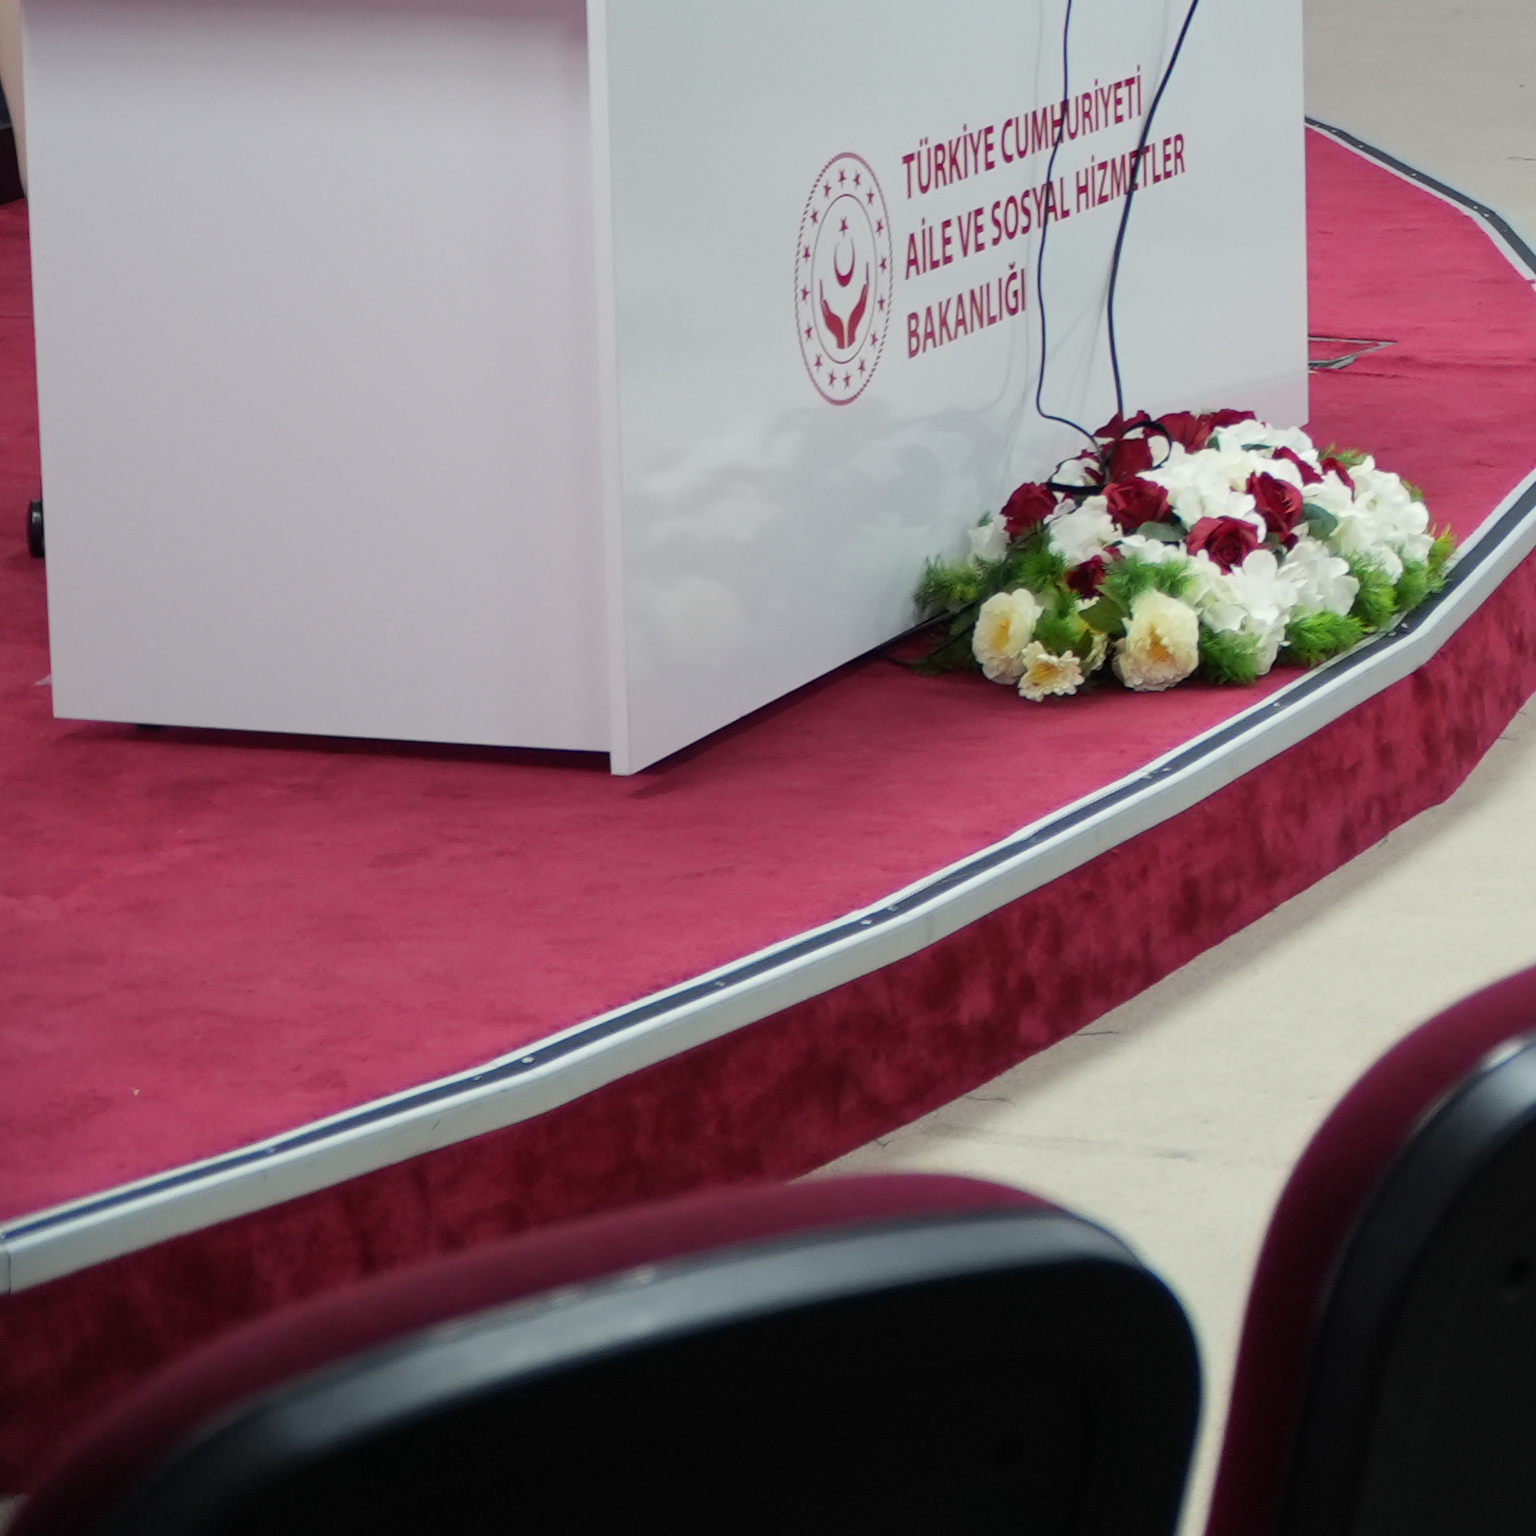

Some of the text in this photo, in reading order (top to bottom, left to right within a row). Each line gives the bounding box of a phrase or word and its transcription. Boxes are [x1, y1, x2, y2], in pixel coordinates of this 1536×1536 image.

[901, 64, 1142, 200] TÜRKİYE CUMHURİYETİ
[904, 133, 1186, 280] AİLE VE SOSYAL HİZMETLER
[906, 261, 1027, 360] BAKANLIĞI
